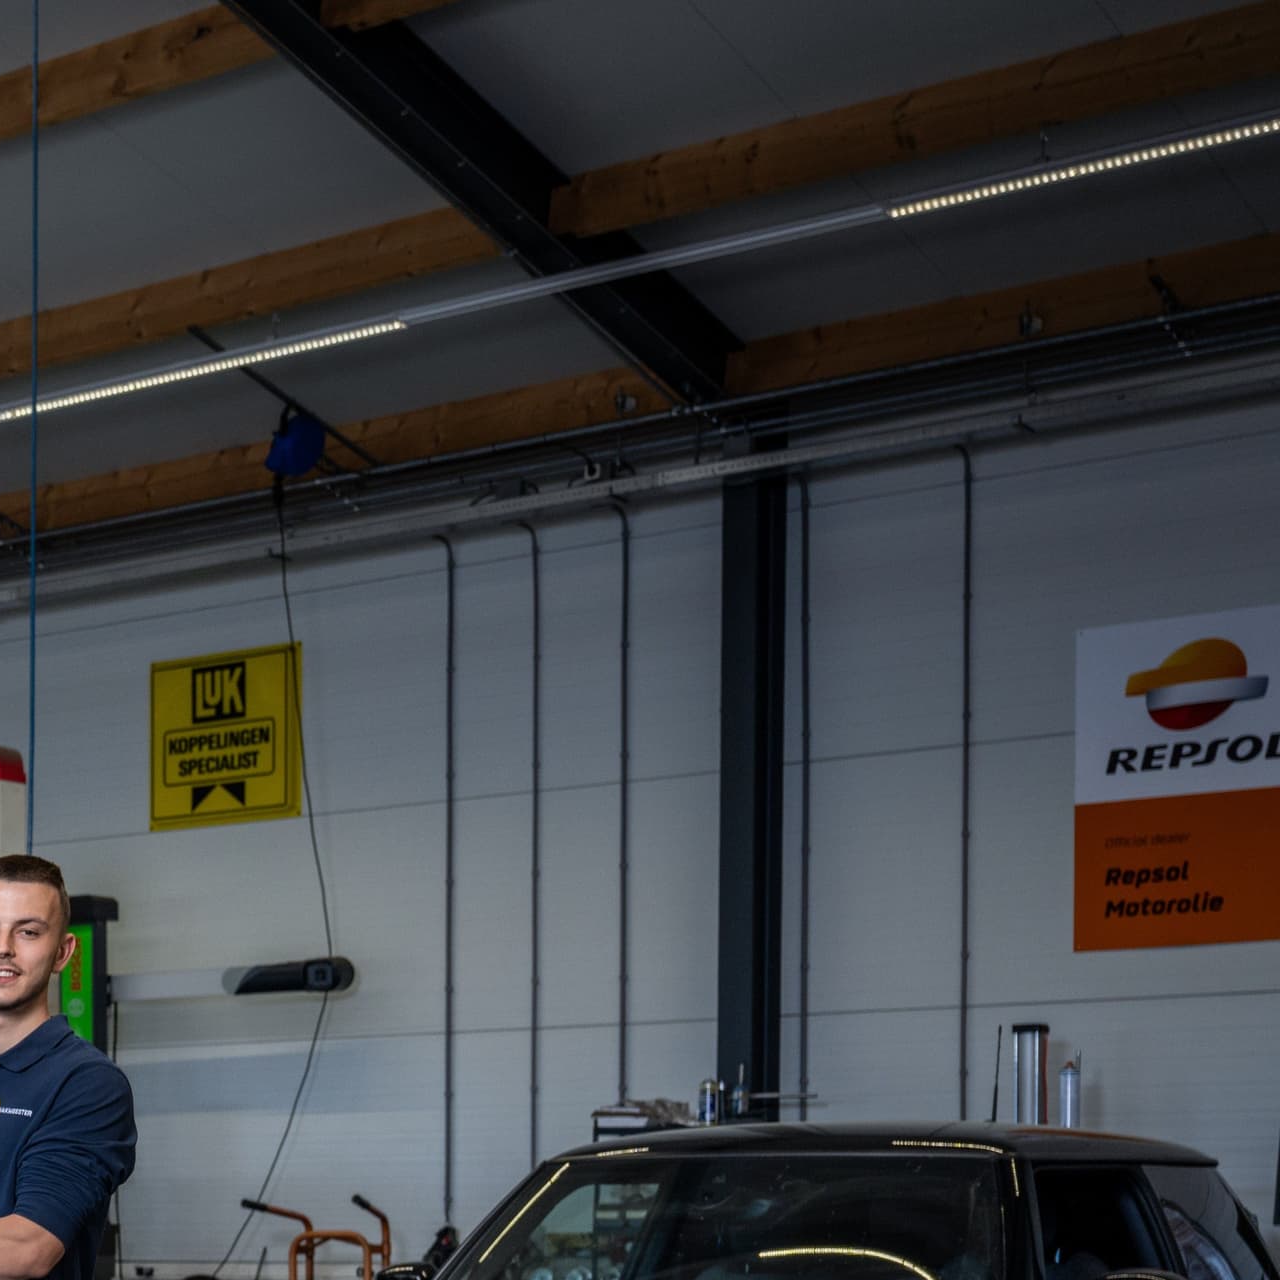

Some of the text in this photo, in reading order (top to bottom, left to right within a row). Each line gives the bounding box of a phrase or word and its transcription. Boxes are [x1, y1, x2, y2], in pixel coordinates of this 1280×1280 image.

[168, 726, 270, 755] KOPPELINGEN
[178, 751, 260, 777] SPECIALIST
[1105, 861, 1189, 888] Repsol
[1105, 892, 1224, 918] Motorolie
